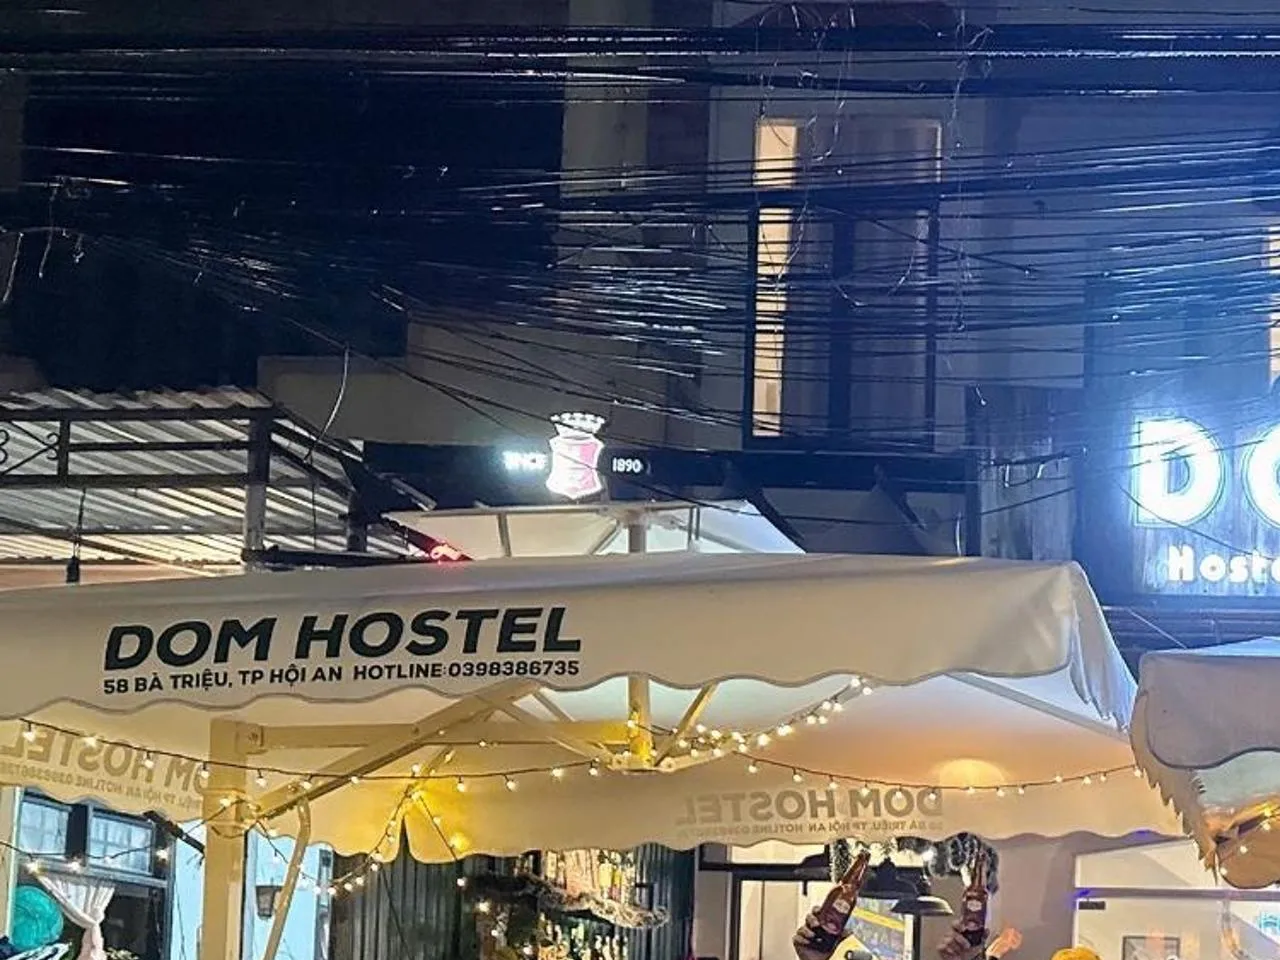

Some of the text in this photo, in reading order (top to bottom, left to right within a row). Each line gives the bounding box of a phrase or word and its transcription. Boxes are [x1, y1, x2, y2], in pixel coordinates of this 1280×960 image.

[612, 457, 642, 473] 1890
[104, 607, 582, 671] DOM HOSTEL
[103, 679, 129, 694] 58
[134, 672, 164, 693] BÀ
[169, 668, 233, 692] TRIỆU,
[238, 669, 264, 686] TP
[269, 664, 306, 688] HỘI
[312, 666, 343, 682] AN
